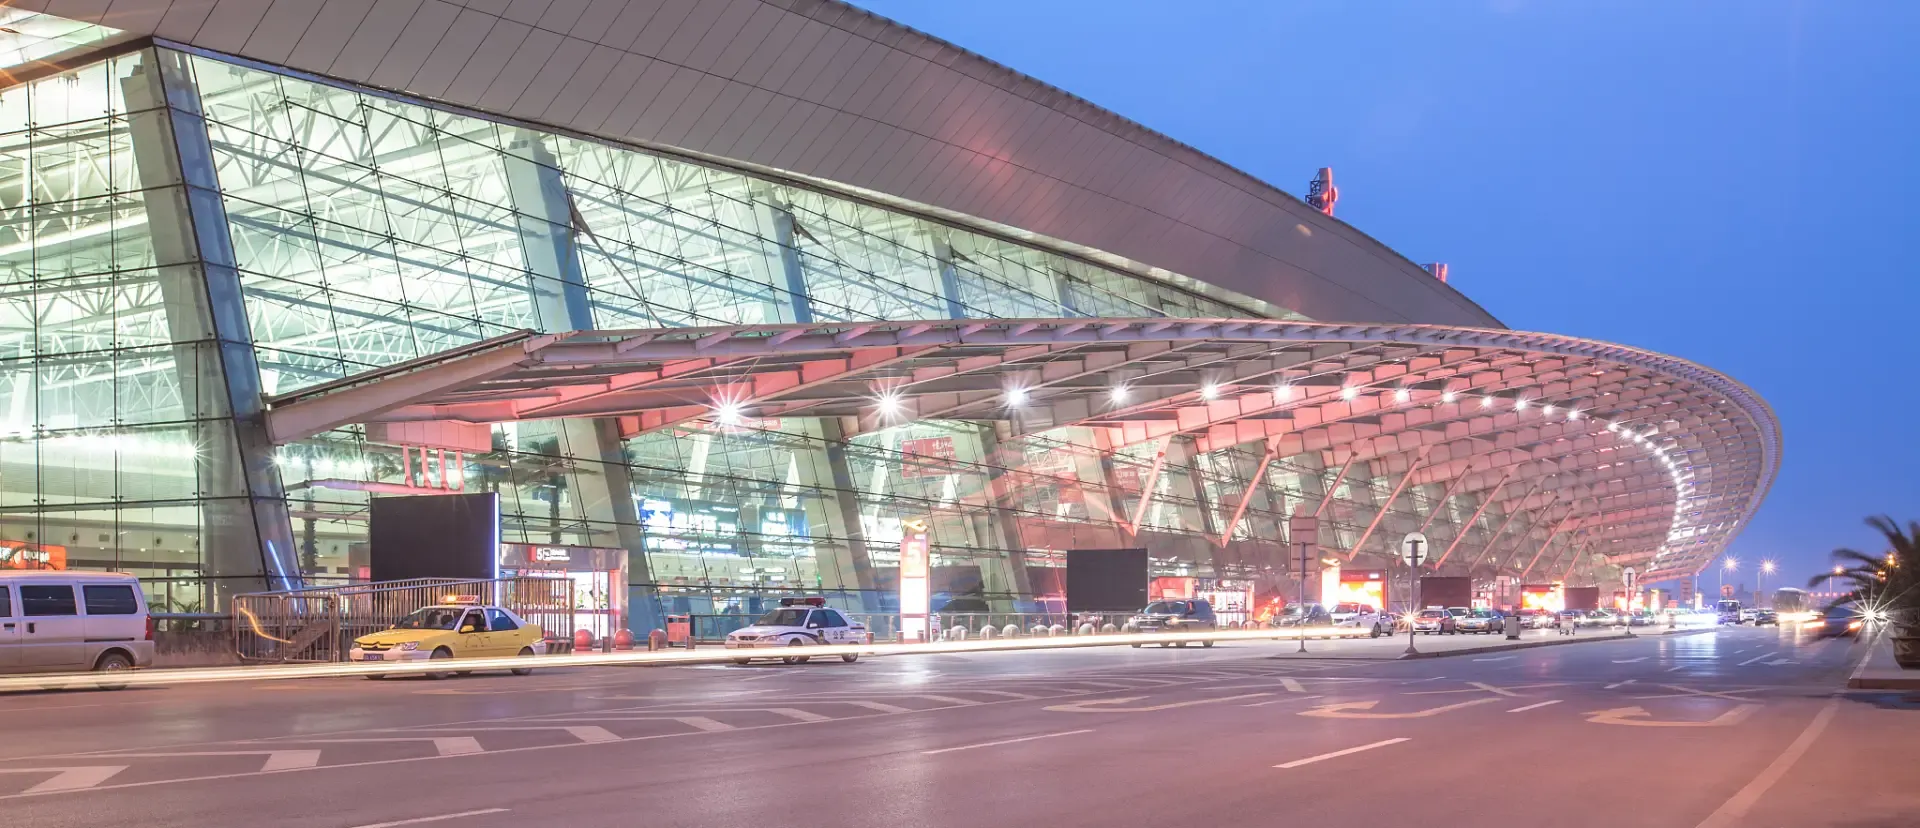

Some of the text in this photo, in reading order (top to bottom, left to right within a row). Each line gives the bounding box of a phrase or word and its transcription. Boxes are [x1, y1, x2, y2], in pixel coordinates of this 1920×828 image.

[536, 548, 543, 560] 5
[906, 541, 922, 568] 5
[833, 630, 844, 640] 公安
